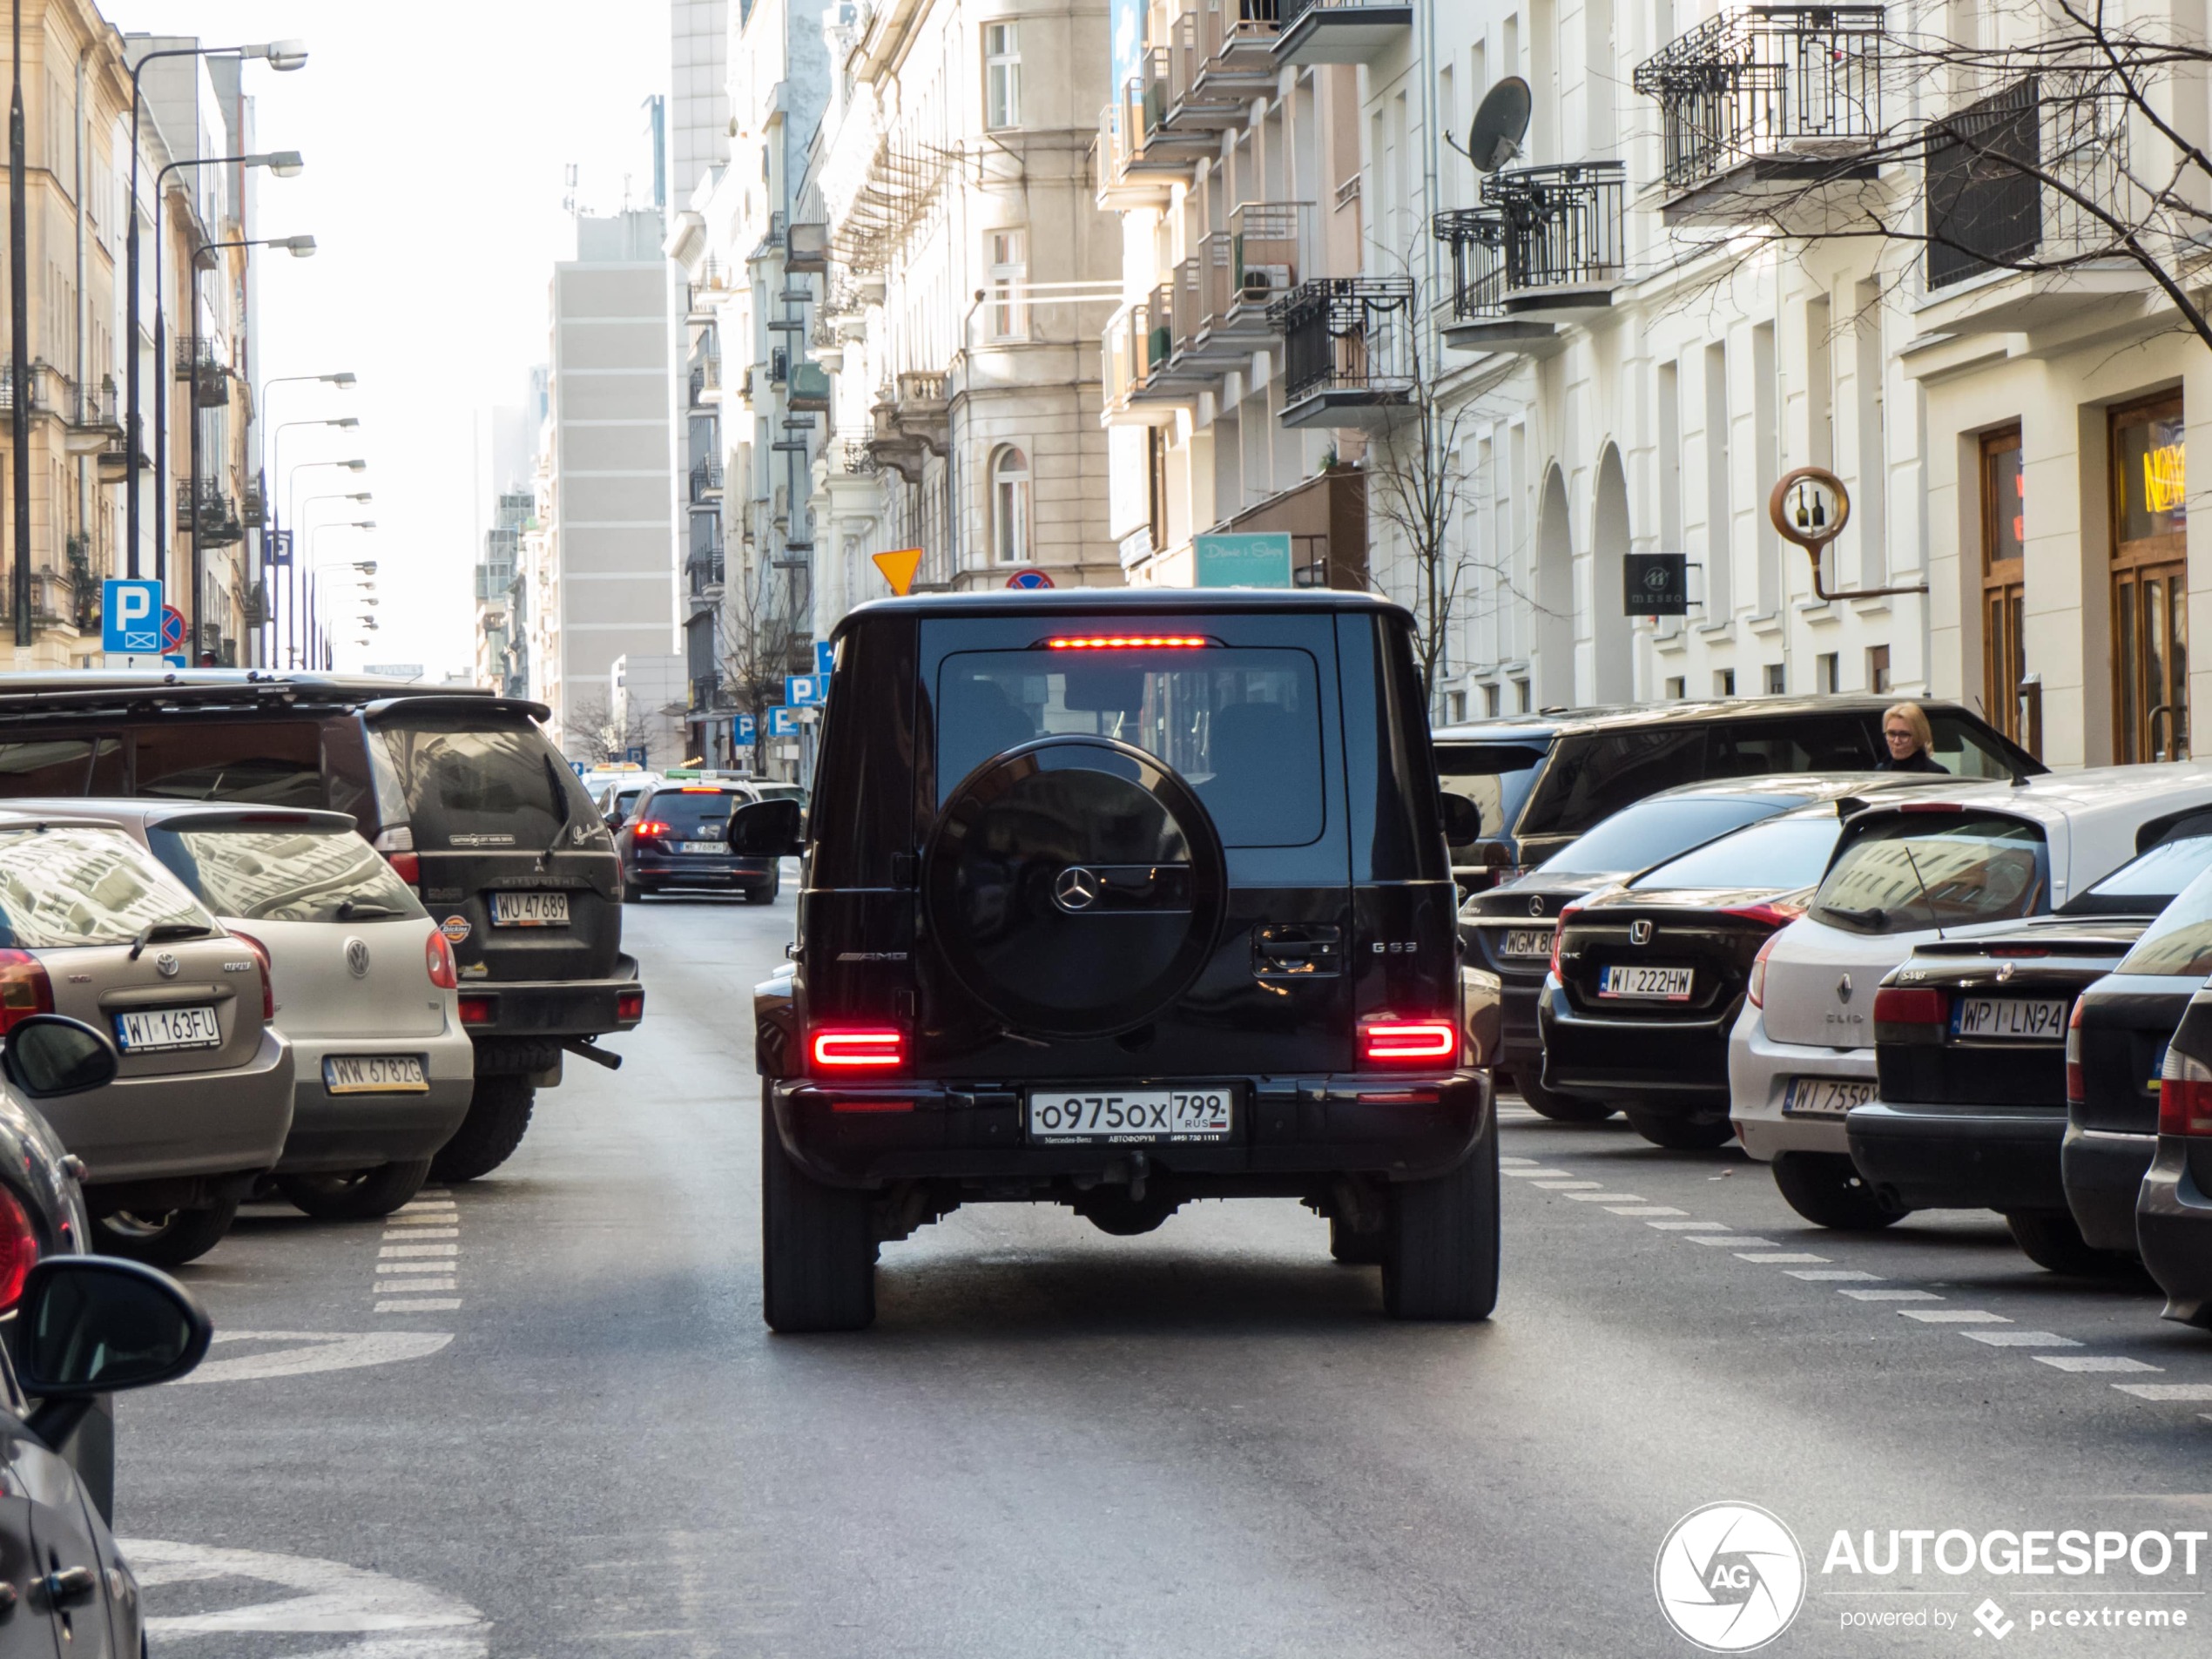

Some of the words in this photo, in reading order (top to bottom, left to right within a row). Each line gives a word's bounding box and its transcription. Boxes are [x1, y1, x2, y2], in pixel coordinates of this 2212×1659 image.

[116, 586, 150, 631] P
[792, 679, 812, 704] P
[740, 718, 753, 736] P
[498, 895, 521, 918] WU
[525, 895, 566, 918] 47689
[1372, 942, 1385, 953] G
[1507, 933, 1536, 953] WGM
[1611, 969, 1629, 991] WI
[1637, 970, 1690, 994] 222HW
[1901, 970, 1926, 981] SAAB
[127, 1015, 152, 1043] WI
[160, 1010, 215, 1040] 163FU
[1826, 1013, 1865, 1024] CLIO
[334, 1059, 364, 1084] WW
[369, 1058, 421, 1084] 6782G
[1174, 1095, 1220, 1119] 799
[1795, 1082, 1818, 1109] WI
[1185, 1119, 1209, 1128] RUS
